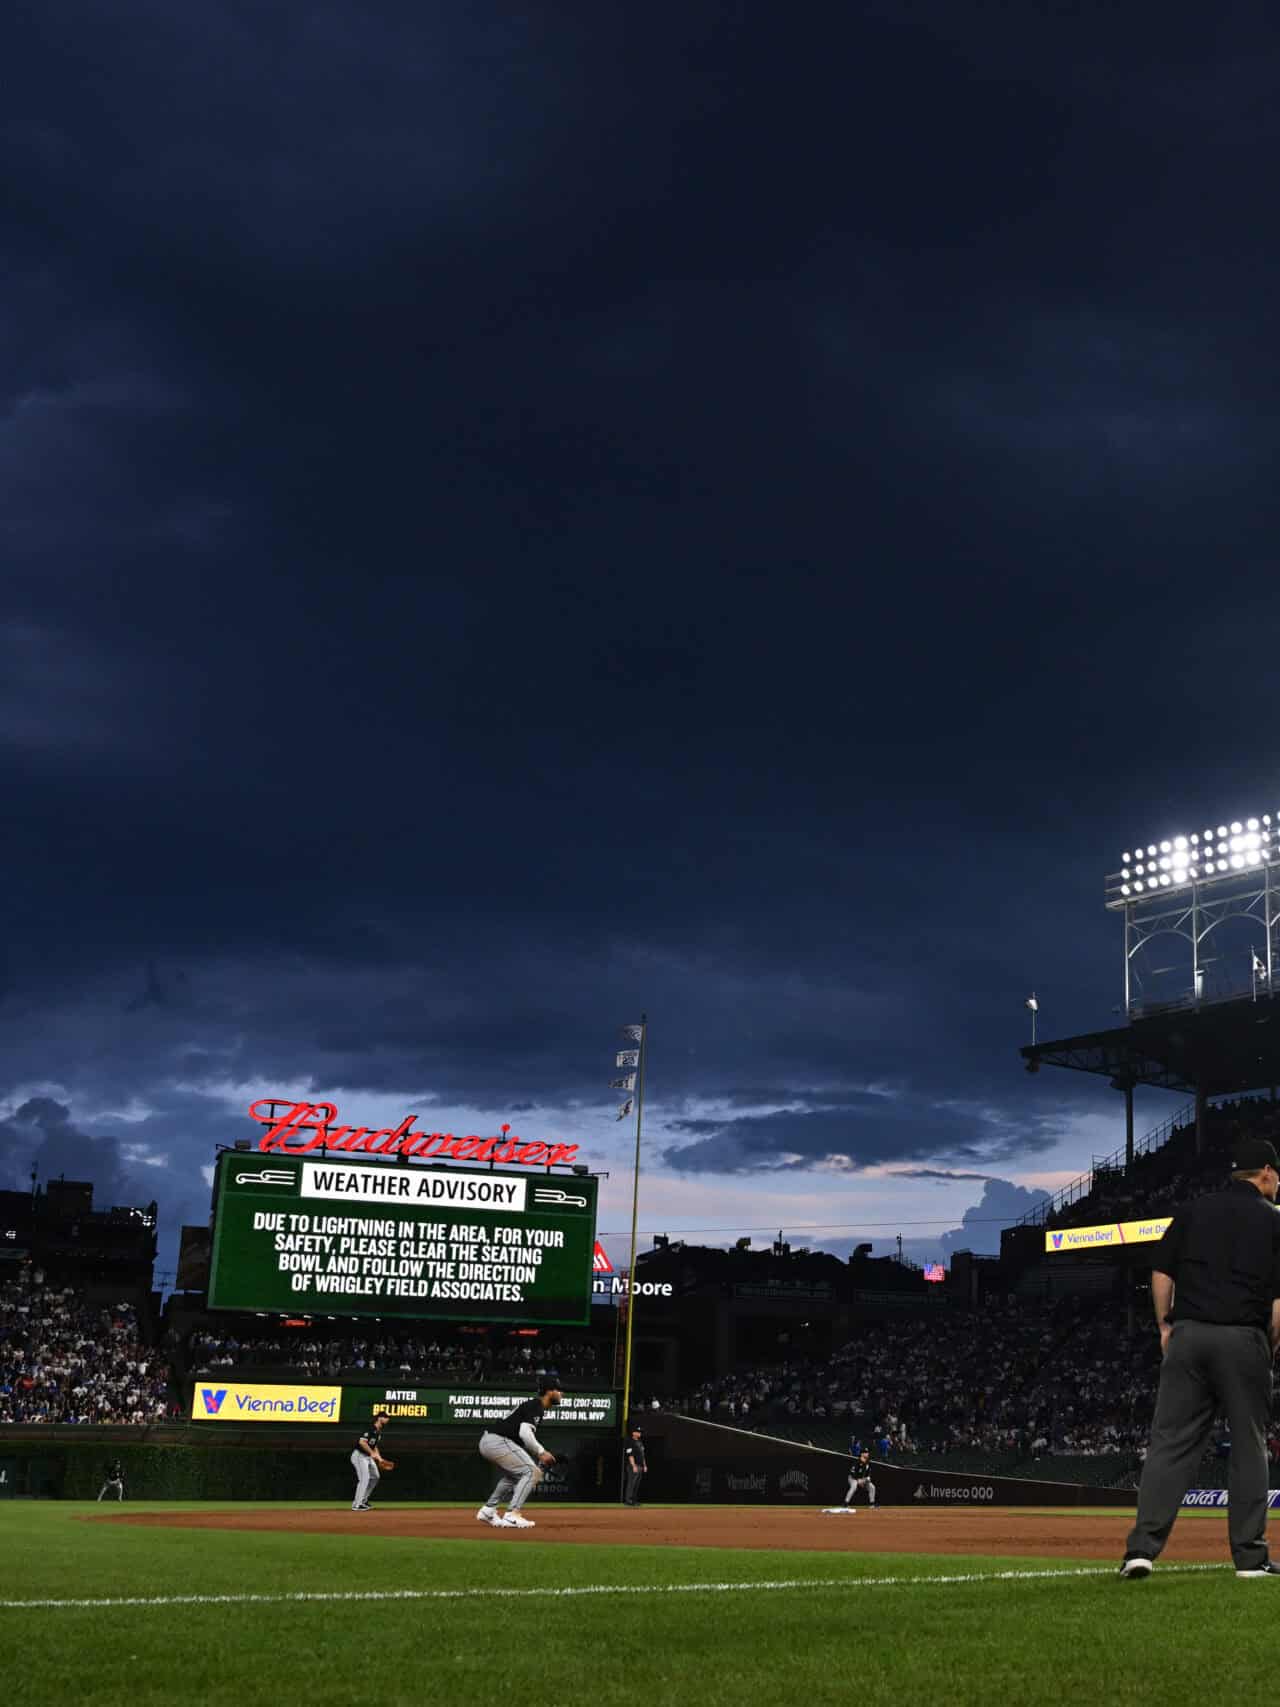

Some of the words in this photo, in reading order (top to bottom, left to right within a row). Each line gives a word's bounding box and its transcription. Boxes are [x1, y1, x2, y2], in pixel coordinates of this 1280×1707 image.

[250, 1099, 579, 1166] Budweiser
[314, 1171, 410, 1197] WEATHER
[417, 1178, 517, 1204] ADVISORY
[253, 1212, 286, 1231] DUE
[289, 1214, 310, 1233] TO
[313, 1216, 395, 1238] LIGHTNING
[398, 1221, 414, 1239] IN
[418, 1222, 447, 1241] THE
[449, 1224, 490, 1244] AREA,
[494, 1227, 522, 1246] FOR
[525, 1229, 564, 1248] YOUR
[1139, 1226, 1152, 1235] Hot
[274, 1233, 336, 1255] SAFETY,
[340, 1236, 397, 1257] PLEASE
[400, 1240, 447, 1260] CLEAR
[450, 1243, 478, 1262] THE
[481, 1245, 543, 1265] SEATING
[278, 1253, 324, 1273] BOWL
[327, 1255, 359, 1274] AND
[362, 1257, 424, 1278] FOLLOW
[427, 1261, 456, 1280] THE
[459, 1263, 536, 1284] DIRECTION
[291, 1273, 313, 1292] OF
[316, 1275, 385, 1295] WRIGLEY
[386, 1278, 428, 1297] FIELD
[431, 1281, 525, 1302] ASSOCIATES.
[612, 1277, 673, 1296] Moore
[385, 1390, 417, 1401] BATTER
[449, 1395, 474, 1405] PLAYED
[481, 1396, 510, 1406] SEASONS
[573, 1398, 612, 1408] (2017-2022)
[235, 1394, 294, 1412] Vienna
[297, 1396, 337, 1417] Beef
[373, 1404, 428, 1417] BELLINGER
[454, 1408, 472, 1418] 2017
[473, 1409, 482, 1418] NL
[579, 1412, 587, 1420] NL
[589, 1411, 606, 1420] MVP
[931, 1484, 970, 1498] Invesco
